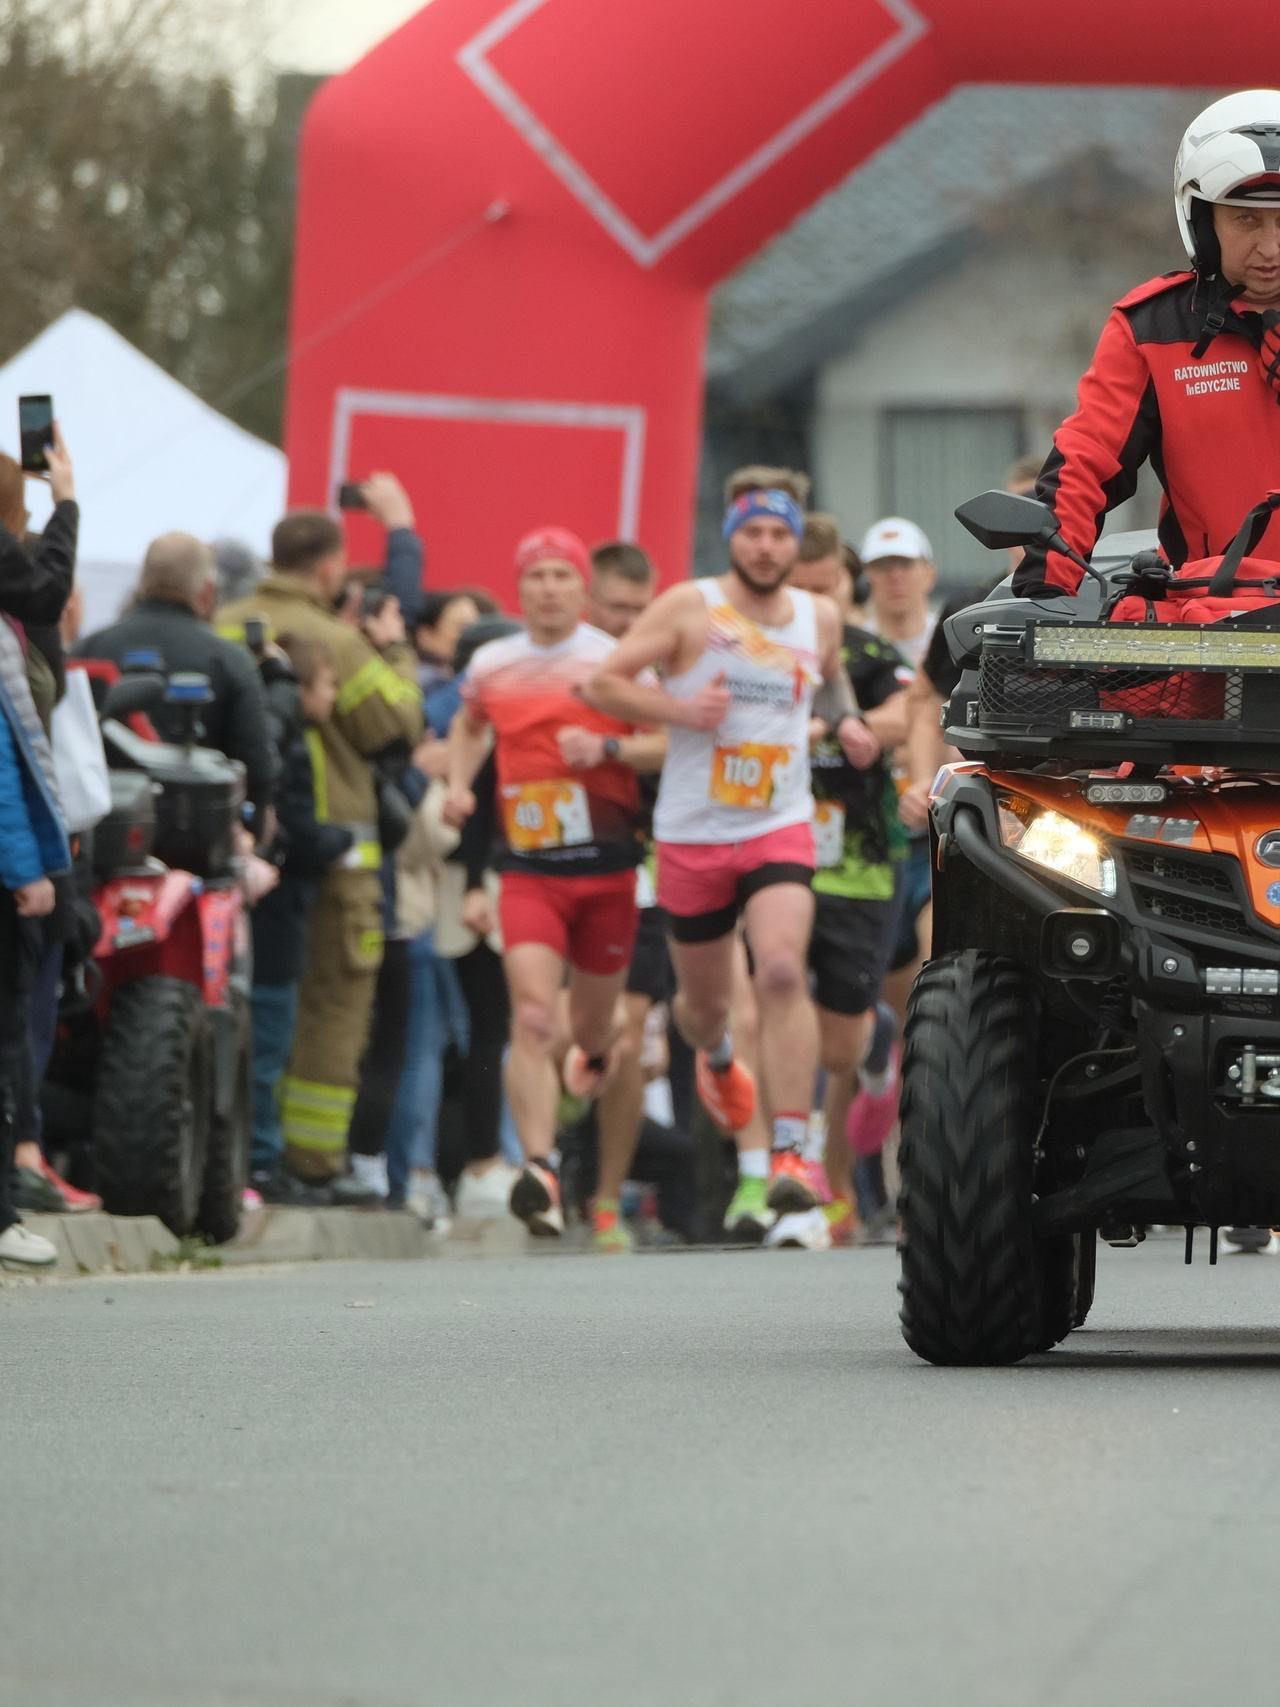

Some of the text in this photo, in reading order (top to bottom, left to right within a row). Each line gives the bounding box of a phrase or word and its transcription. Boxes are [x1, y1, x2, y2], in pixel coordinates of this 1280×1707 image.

[1174, 360, 1248, 381] RATOWNICTWO
[722, 755, 763, 788] 110
[514, 800, 545, 831] 40
